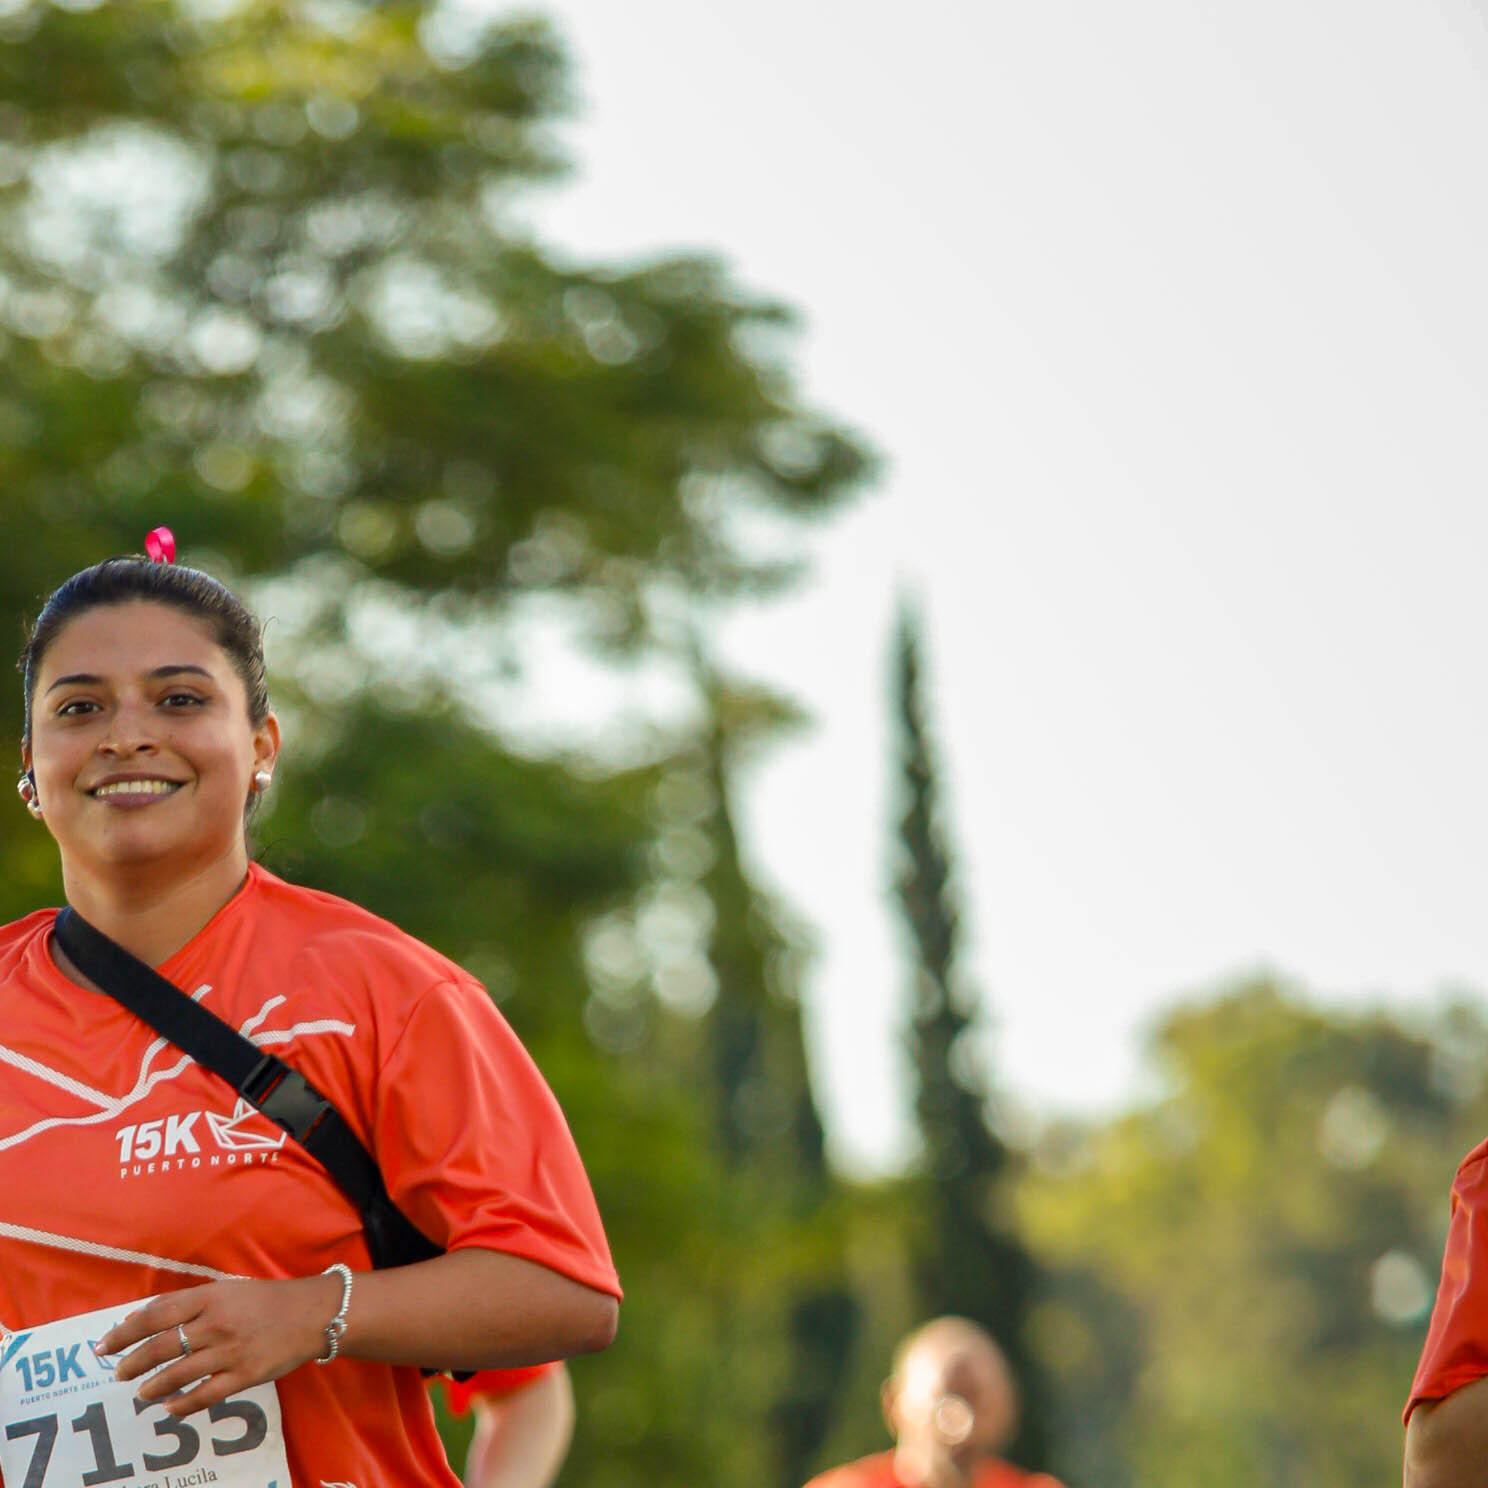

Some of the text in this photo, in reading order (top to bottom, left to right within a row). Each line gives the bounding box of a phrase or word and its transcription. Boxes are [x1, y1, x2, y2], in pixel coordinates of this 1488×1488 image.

[115, 1111, 202, 1163] 15K
[120, 1157, 201, 1179] PUERTO
[15, 1343, 87, 1392] 15K
[20, 1392, 51, 1406] PUERTO
[52, 1386, 78, 1398] NORTE
